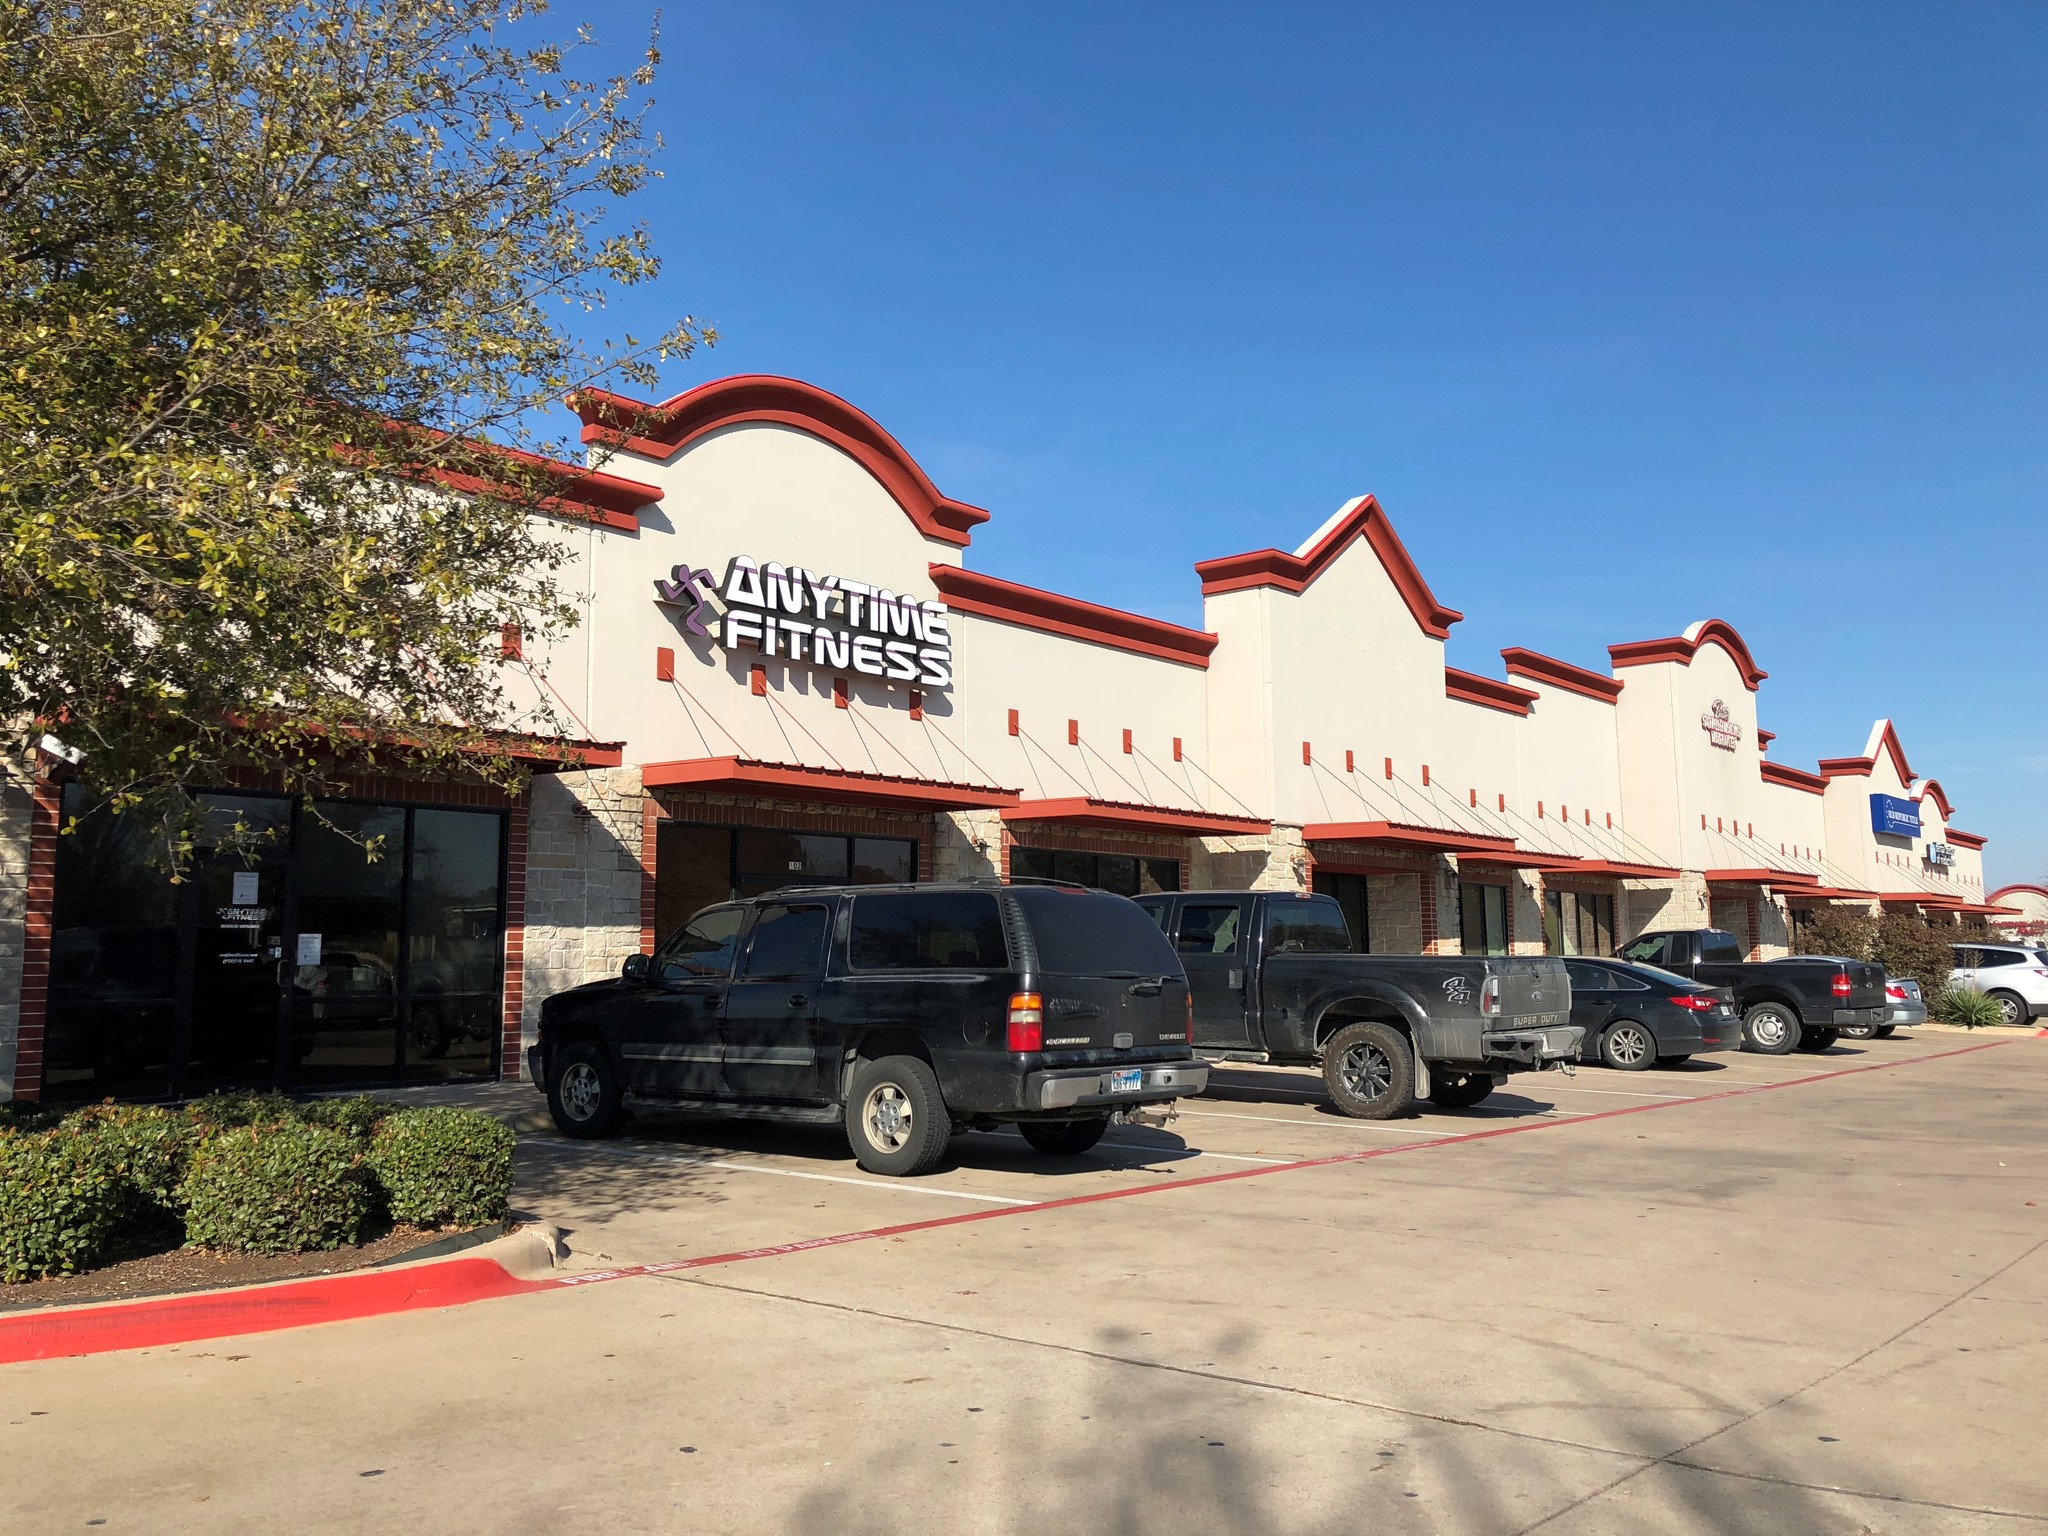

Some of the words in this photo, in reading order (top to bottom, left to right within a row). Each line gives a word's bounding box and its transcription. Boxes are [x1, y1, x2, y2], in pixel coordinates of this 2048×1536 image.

[723, 555, 948, 646] ANYTIME
[722, 609, 950, 687] FITNESS
[790, 862, 801, 870] 102
[1513, 1017, 1537, 1026] SUPER
[1540, 1014, 1559, 1024] DUTY
[558, 1270, 630, 1285] FIRE
